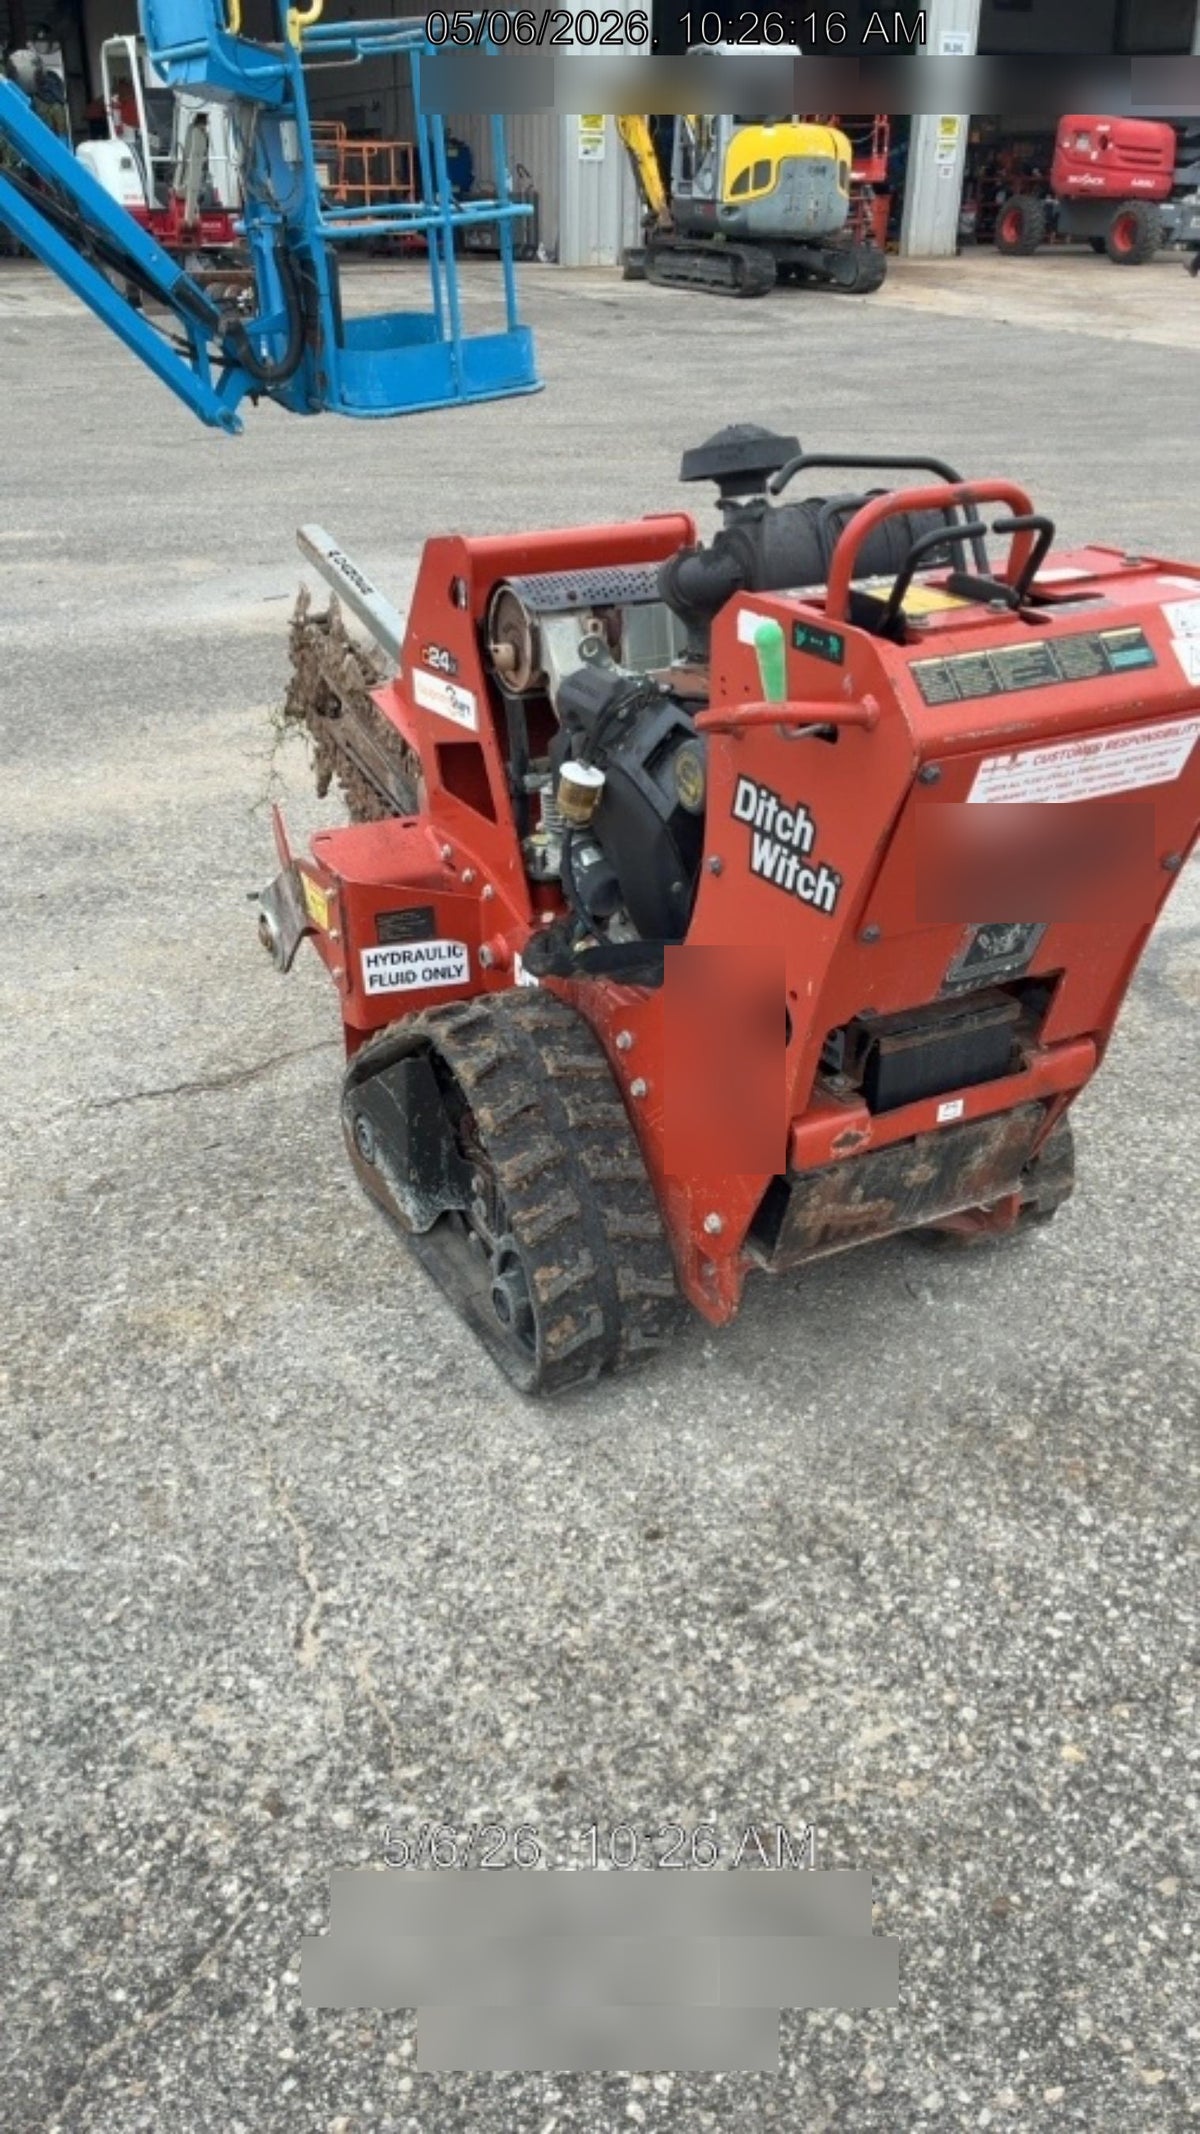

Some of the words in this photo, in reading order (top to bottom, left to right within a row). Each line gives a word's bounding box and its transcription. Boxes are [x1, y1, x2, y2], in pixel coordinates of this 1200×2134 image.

[734, 779, 815, 852] Ditch
[751, 831, 837, 912] Witch
[366, 944, 463, 969] HYDRAULIC
[368, 969, 417, 988] FLUID
[421, 964, 464, 983] ONLY
